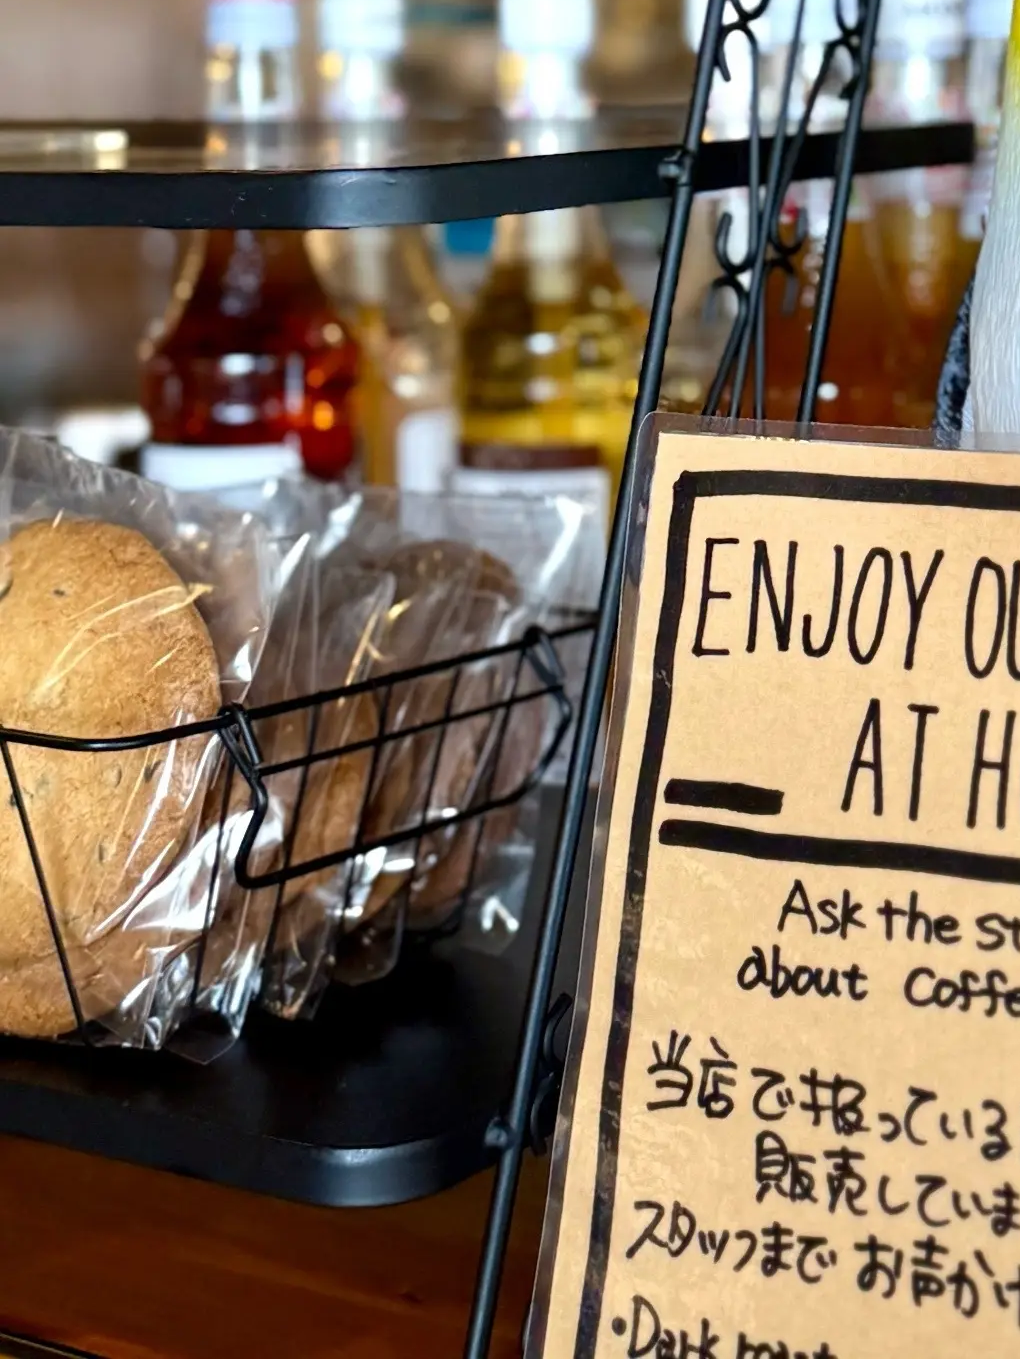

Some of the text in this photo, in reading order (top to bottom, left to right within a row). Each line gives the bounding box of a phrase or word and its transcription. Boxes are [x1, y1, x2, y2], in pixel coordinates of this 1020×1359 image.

[691, 536, 945, 672] ENJOY
[840, 697, 940, 822] AT
[777, 879, 867, 940] Ask
[877, 890, 962, 945] the
[737, 944, 869, 1000] about
